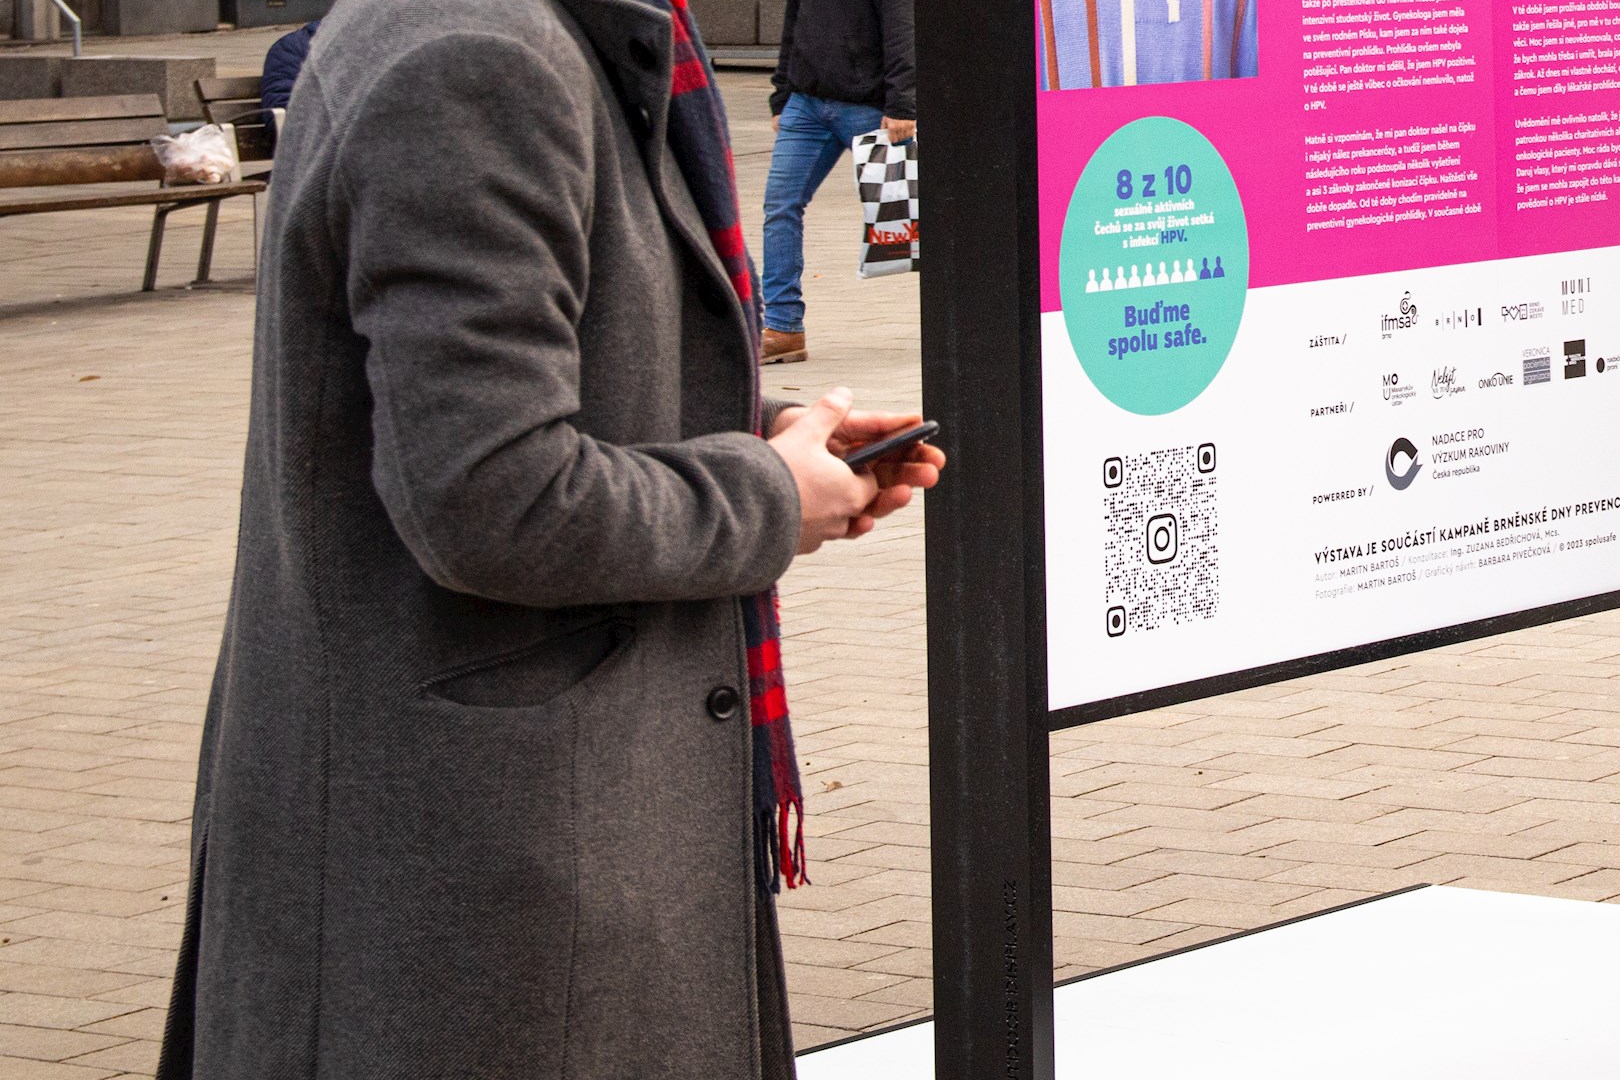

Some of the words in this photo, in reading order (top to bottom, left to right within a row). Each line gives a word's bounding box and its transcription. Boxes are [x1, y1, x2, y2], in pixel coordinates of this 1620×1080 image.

[1116, 169, 1133, 200] 8
[1142, 174, 1156, 198] z
[1165, 164, 1192, 195] 10
[1114, 201, 1153, 217] sexuálně
[1155, 198, 1194, 213] aktivních
[1094, 221, 1121, 235] Čechů
[1123, 223, 1132, 232] se
[1135, 221, 1145, 231] za
[1148, 216, 1165, 231] svůj
[1167, 216, 1189, 228] život
[1191, 212, 1214, 226] setká
[1123, 240, 1128, 248] s
[1130, 232, 1159, 248] infekcí
[1161, 229, 1187, 244] HPV.
[1562, 278, 1592, 295] MUNI
[1124, 300, 1190, 328] Buďme
[1562, 298, 1584, 315] MED
[1381, 314, 1411, 331] ifmsa
[1108, 330, 1158, 360] spolu
[1164, 322, 1208, 347] safe.
[1310, 335, 1340, 348] ZÁŠTITA
[1310, 402, 1347, 417] PARTNEŘI
[1432, 431, 1465, 446] NADACE
[1468, 428, 1484, 441] PRO
[1432, 448, 1467, 465] VÝZKUM
[1469, 442, 1510, 458] RAKOVINY
[1432, 468, 1451, 480] Česká
[1452, 465, 1480, 478] republika
[1312, 489, 1355, 504] POWERRED
[1358, 487, 1367, 497] BY
[1315, 545, 1363, 564] VÝSTAVA
[1366, 542, 1377, 555] JE
[1381, 527, 1436, 552] SOUČÁSTÍ
[1440, 517, 1490, 542] KAMPANĚ
[1494, 506, 1547, 532] BRNĚNSKÉ
[1551, 506, 1572, 520] DNY
[1371, 556, 1399, 572] BARTOŠ
[1450, 548, 1464, 558] Ing.
[1466, 541, 1494, 554] ZUZANA
[1496, 530, 1543, 548] BEDŘICHOVÁ,
[1357, 578, 1386, 592] MARTIN
[1388, 569, 1416, 585] BARTOŠ
[1479, 555, 1510, 568] BARBARA
[1512, 543, 1551, 561] PIVEČKOVÁ
[1566, 539, 1583, 550] 2023
[1585, 532, 1616, 548] spolusafe
